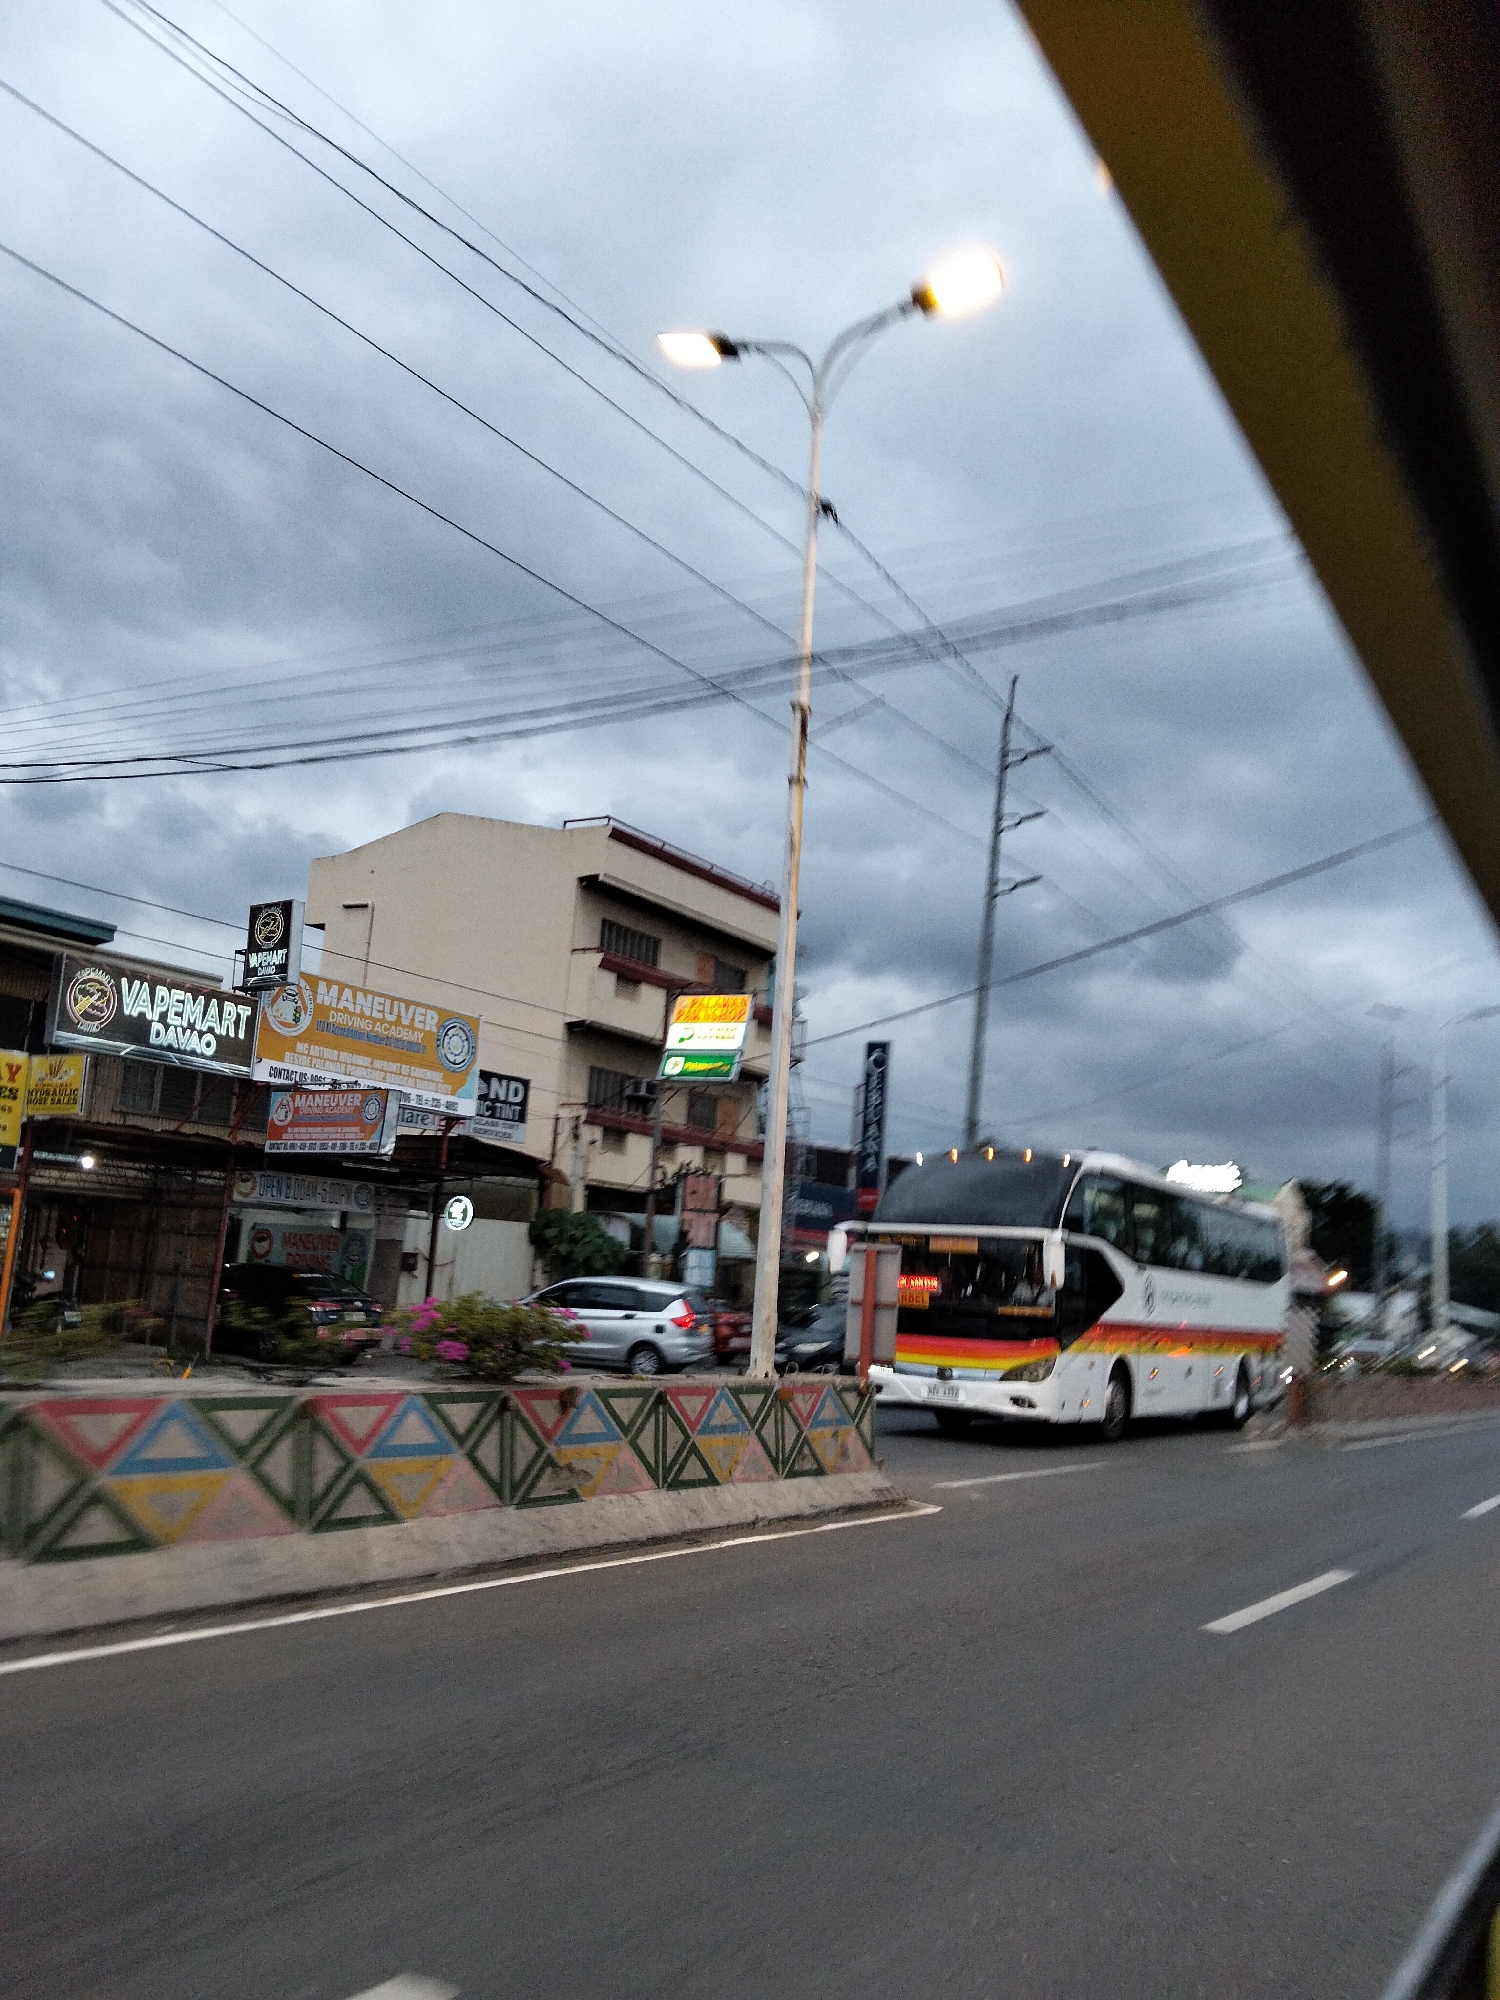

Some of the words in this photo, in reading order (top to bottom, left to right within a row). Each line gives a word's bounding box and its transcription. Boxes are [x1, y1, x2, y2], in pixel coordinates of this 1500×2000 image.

[248, 949, 287, 968] VAPEMART
[120, 976, 252, 1041] VAPEMART
[316, 980, 440, 1033] MANEUVER
[329, 1010, 373, 1031] DRIVING
[374, 1021, 425, 1043] ACADEMY
[149, 1020, 218, 1057] DAVAO
[268, 1065, 298, 1083] CONTACT
[27, 1087, 79, 1098] HYDRAULIC
[294, 1093, 363, 1107] MANEUVER
[300, 1105, 325, 1114] DRIVING
[325, 1106, 355, 1114] ACADEMY
[494, 1103, 522, 1121] TINT
[281, 1231, 341, 1253] MANEUVER
